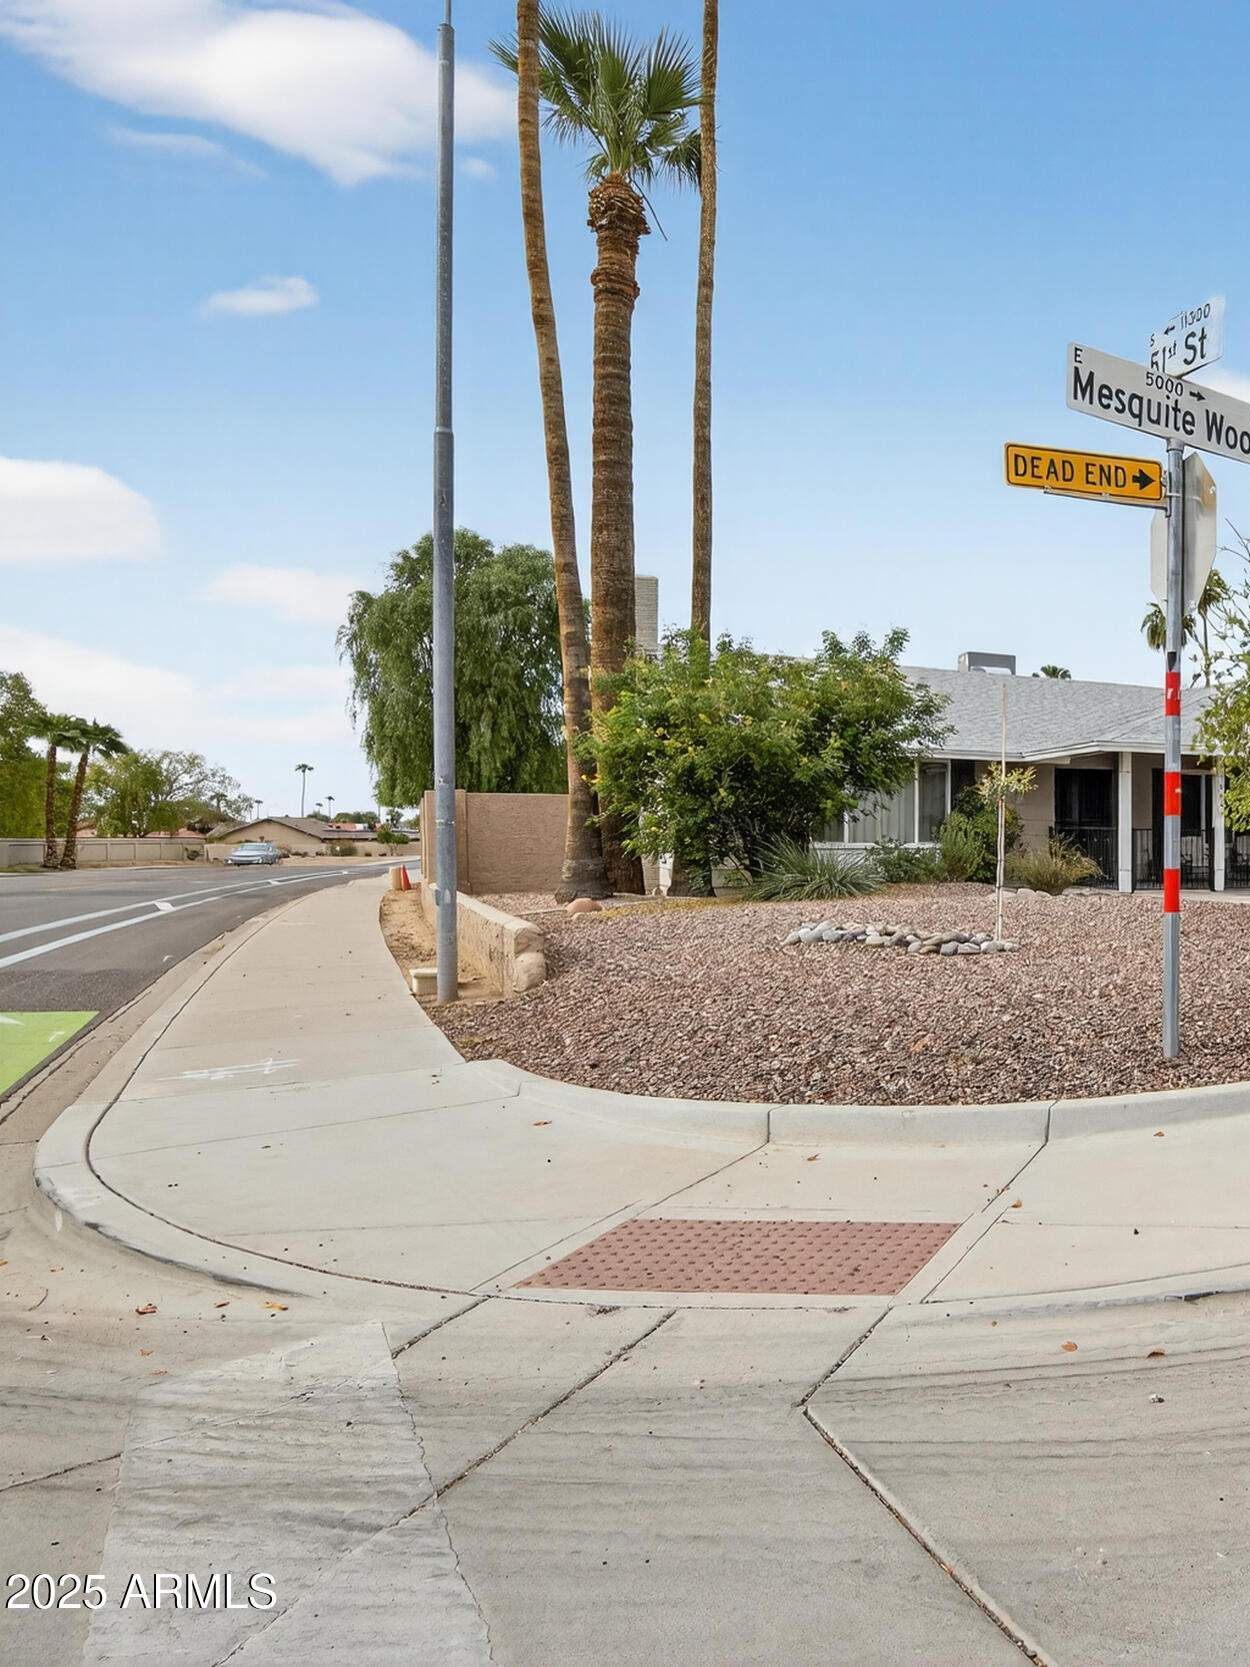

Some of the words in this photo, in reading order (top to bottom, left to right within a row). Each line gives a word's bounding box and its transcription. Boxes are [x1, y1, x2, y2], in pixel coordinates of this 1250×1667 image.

[1181, 303, 1210, 330] 11300
[1183, 327, 1207, 365] St
[1074, 346, 1083, 364] E
[1146, 371, 1184, 397] 5000
[1073, 365, 1196, 436] Mesquite
[1014, 453, 1074, 482] DEAD
[1085, 462, 1127, 488] END
